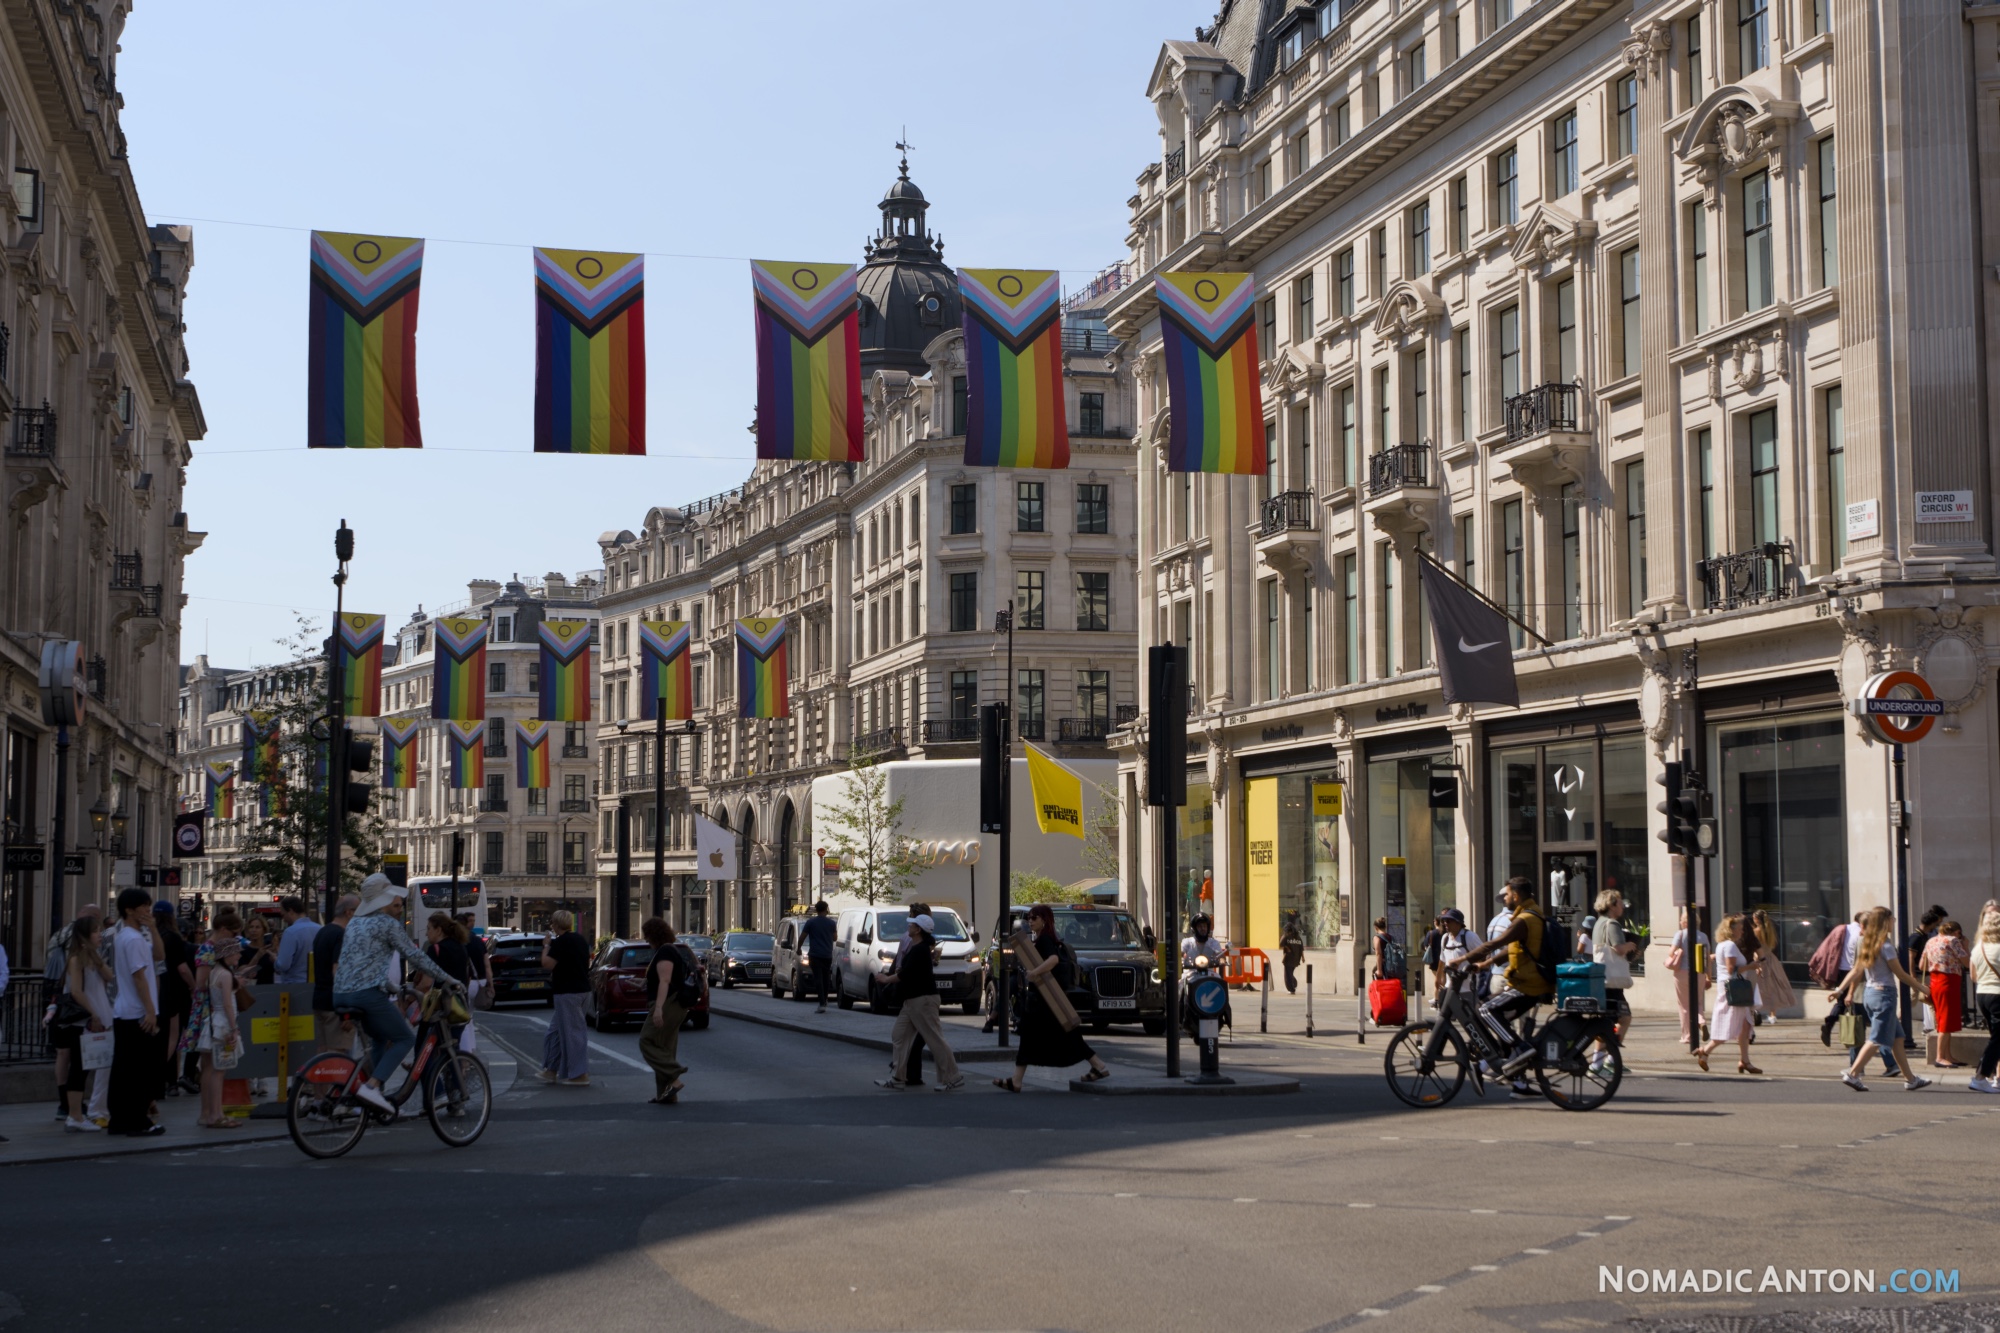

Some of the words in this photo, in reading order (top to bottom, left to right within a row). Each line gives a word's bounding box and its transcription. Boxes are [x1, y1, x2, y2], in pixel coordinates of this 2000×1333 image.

[1921, 494, 1955, 503] OXFORD
[1848, 504, 1867, 515] REGENT
[1921, 503, 1953, 513] CIRCUS
[1955, 503, 1969, 511] W1
[1849, 513, 1866, 524] STREET
[1407, 702, 1428, 720] Tiger
[1869, 701, 1941, 712] UNDERGROUND
[1287, 722, 1304, 741] Tiger
[1044, 810, 1079, 825] TIGER
[1250, 840, 1273, 850] ONITSUKA
[8, 851, 42, 863] KIKO
[1250, 850, 1273, 865] TIGER
[1102, 1000, 1118, 1008] KF19
[1119, 1000, 1132, 1008] XXS
[1466, 1022, 1490, 1053] PORT
